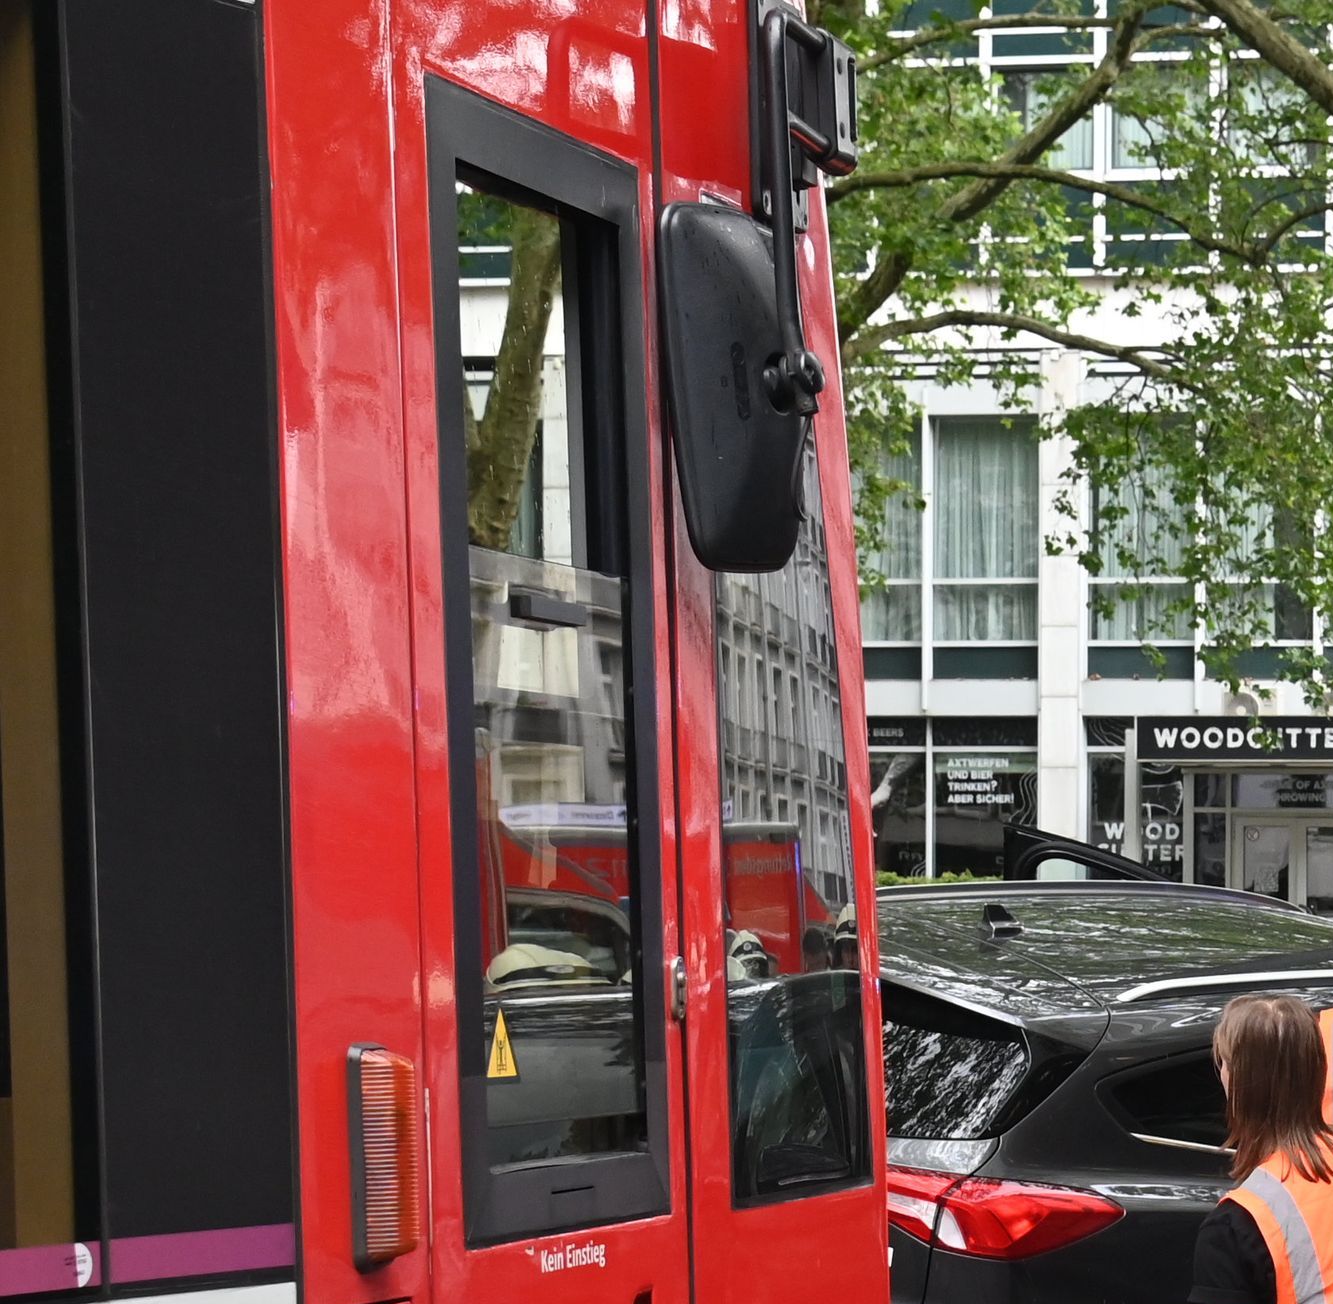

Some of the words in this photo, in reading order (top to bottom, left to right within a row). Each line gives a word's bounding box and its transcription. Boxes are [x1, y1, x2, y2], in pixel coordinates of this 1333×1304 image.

[873, 727, 905, 737] BEERS
[947, 758, 1009, 768] AXTWERFEN
[947, 770, 968, 780] UND
[970, 770, 993, 780] BIER
[947, 781, 998, 792] TRINKEN?
[947, 793, 973, 804] ABER
[975, 792, 1015, 804] SICHER!
[1103, 822, 1180, 840] WOD
[540, 1247, 565, 1273] Kein
[566, 1240, 606, 1268] Einstieg
